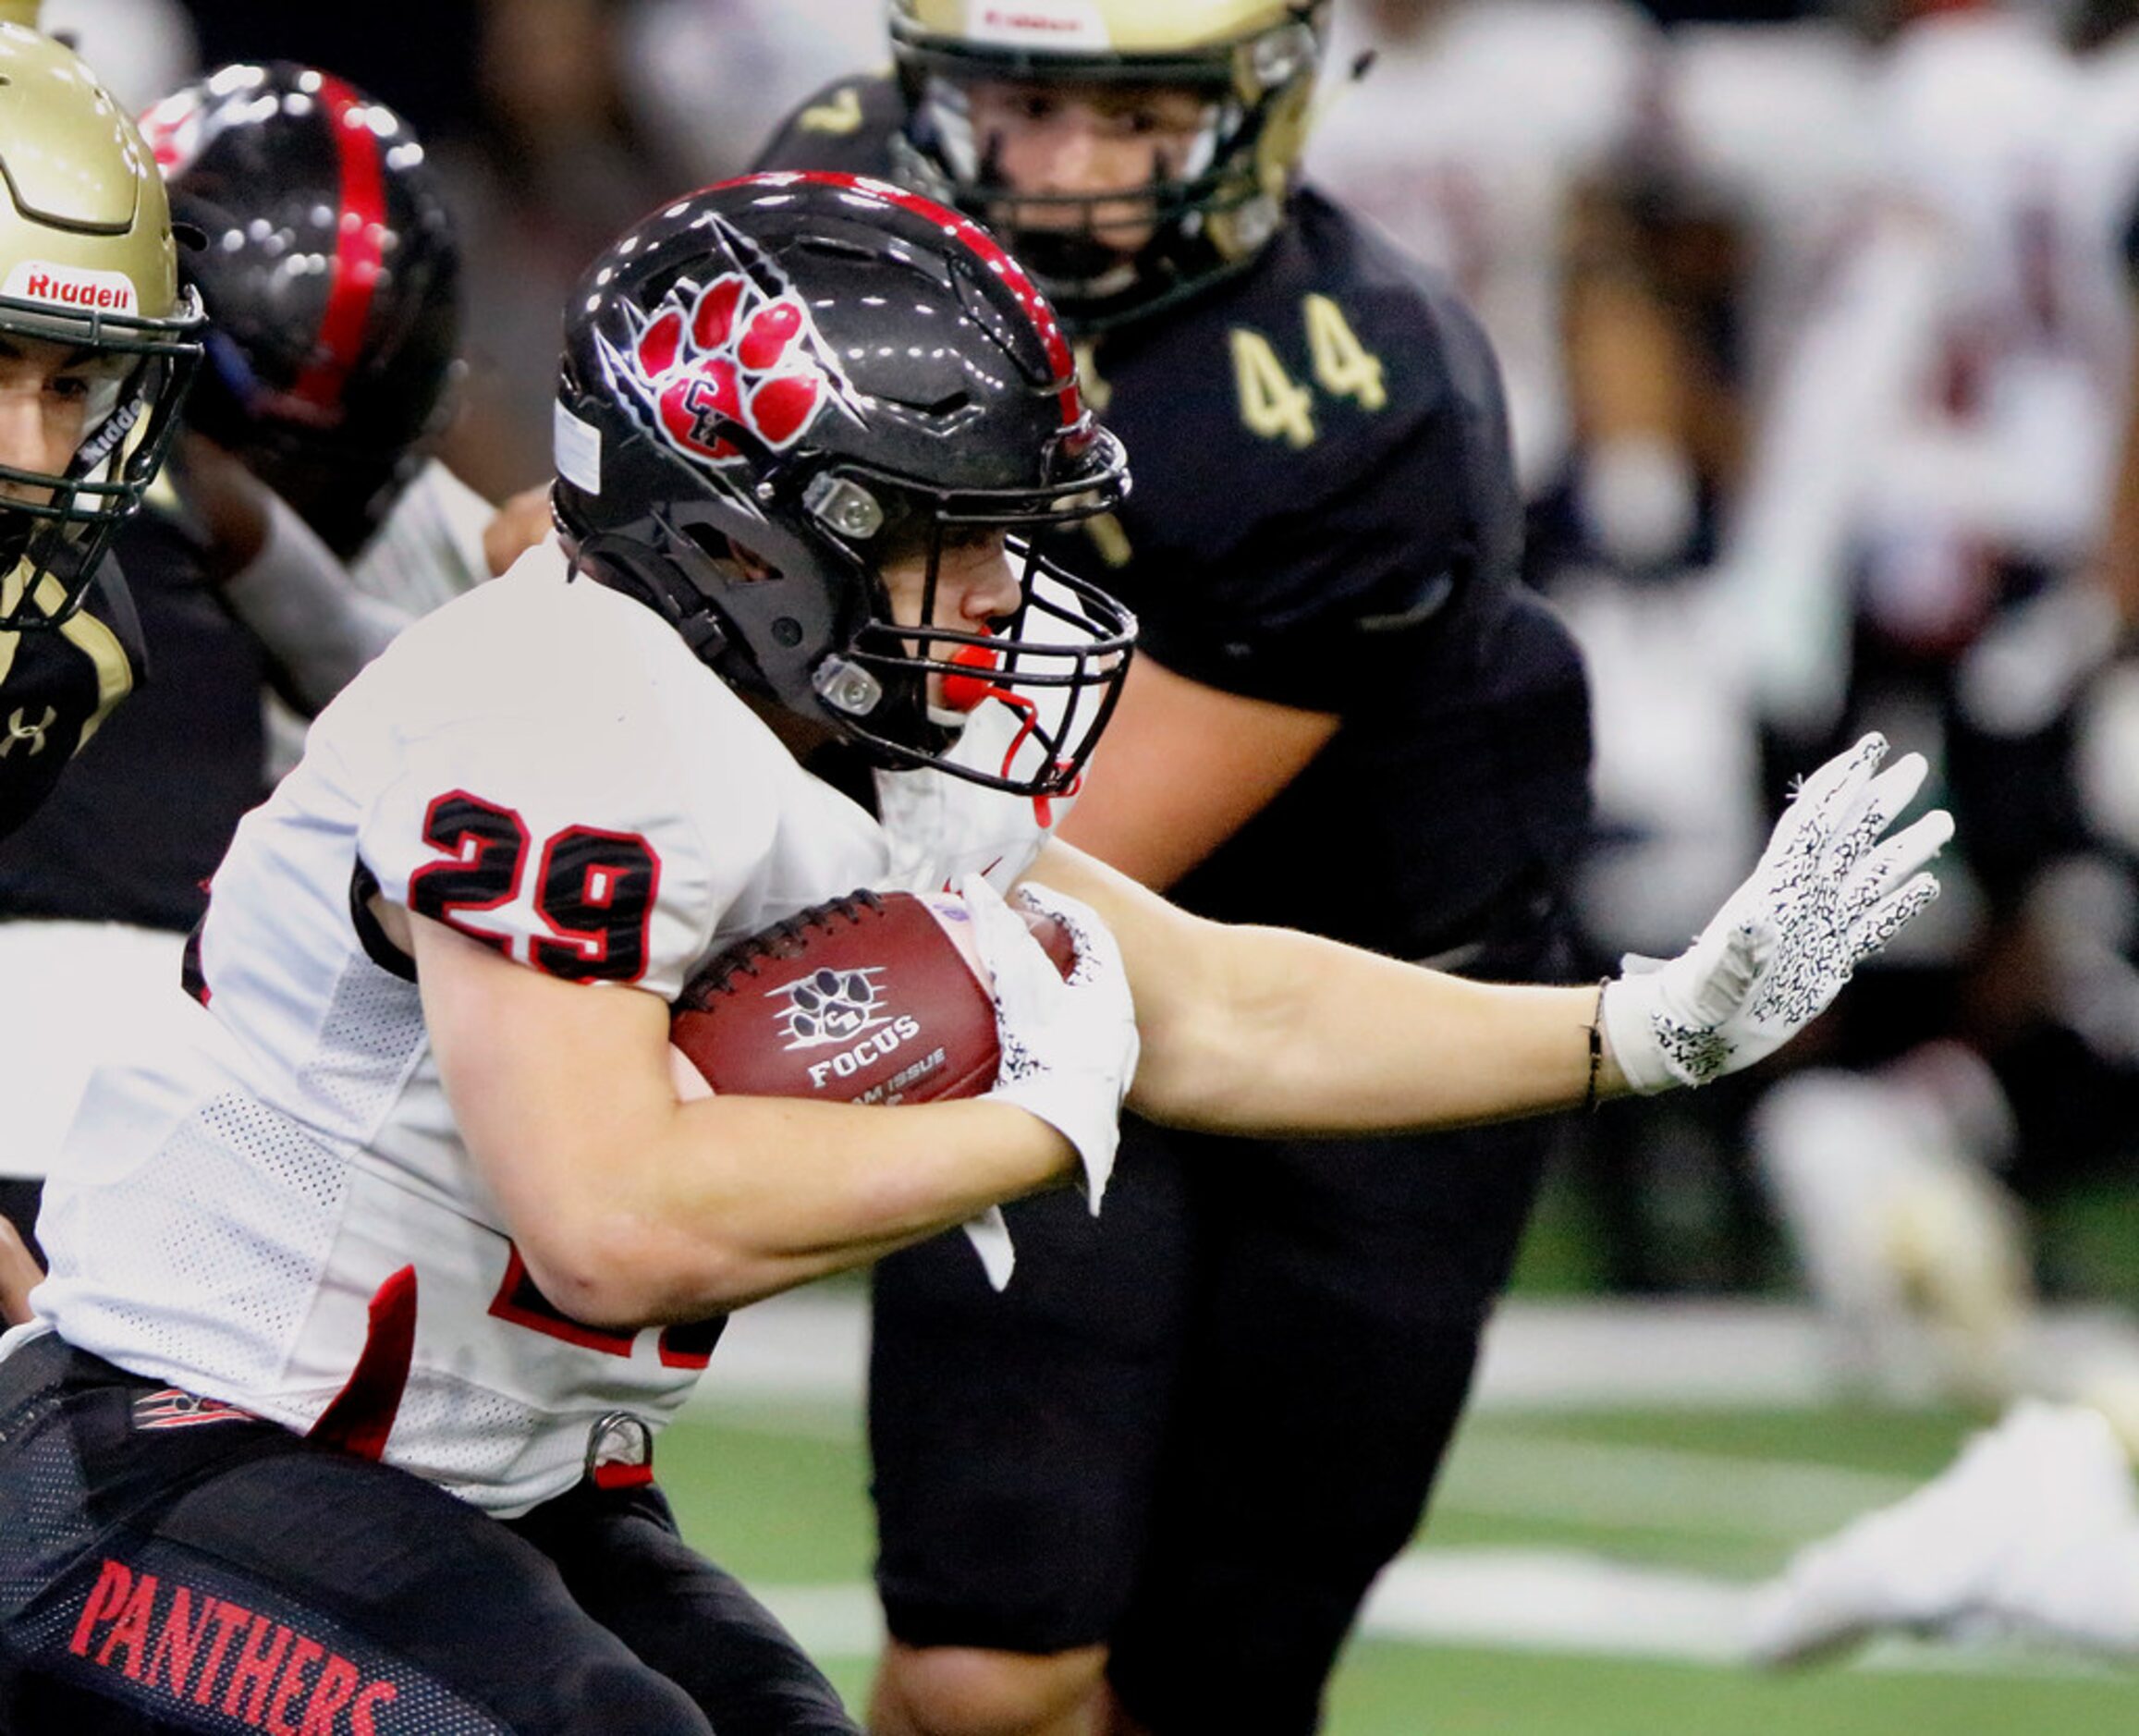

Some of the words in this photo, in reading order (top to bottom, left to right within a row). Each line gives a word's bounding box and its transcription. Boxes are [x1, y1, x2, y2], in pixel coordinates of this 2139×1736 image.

[1228, 292, 1387, 450] 44
[408, 789, 662, 985] 29
[807, 1014, 921, 1088] FOCUS
[887, 1047, 947, 1092] ISSUE
